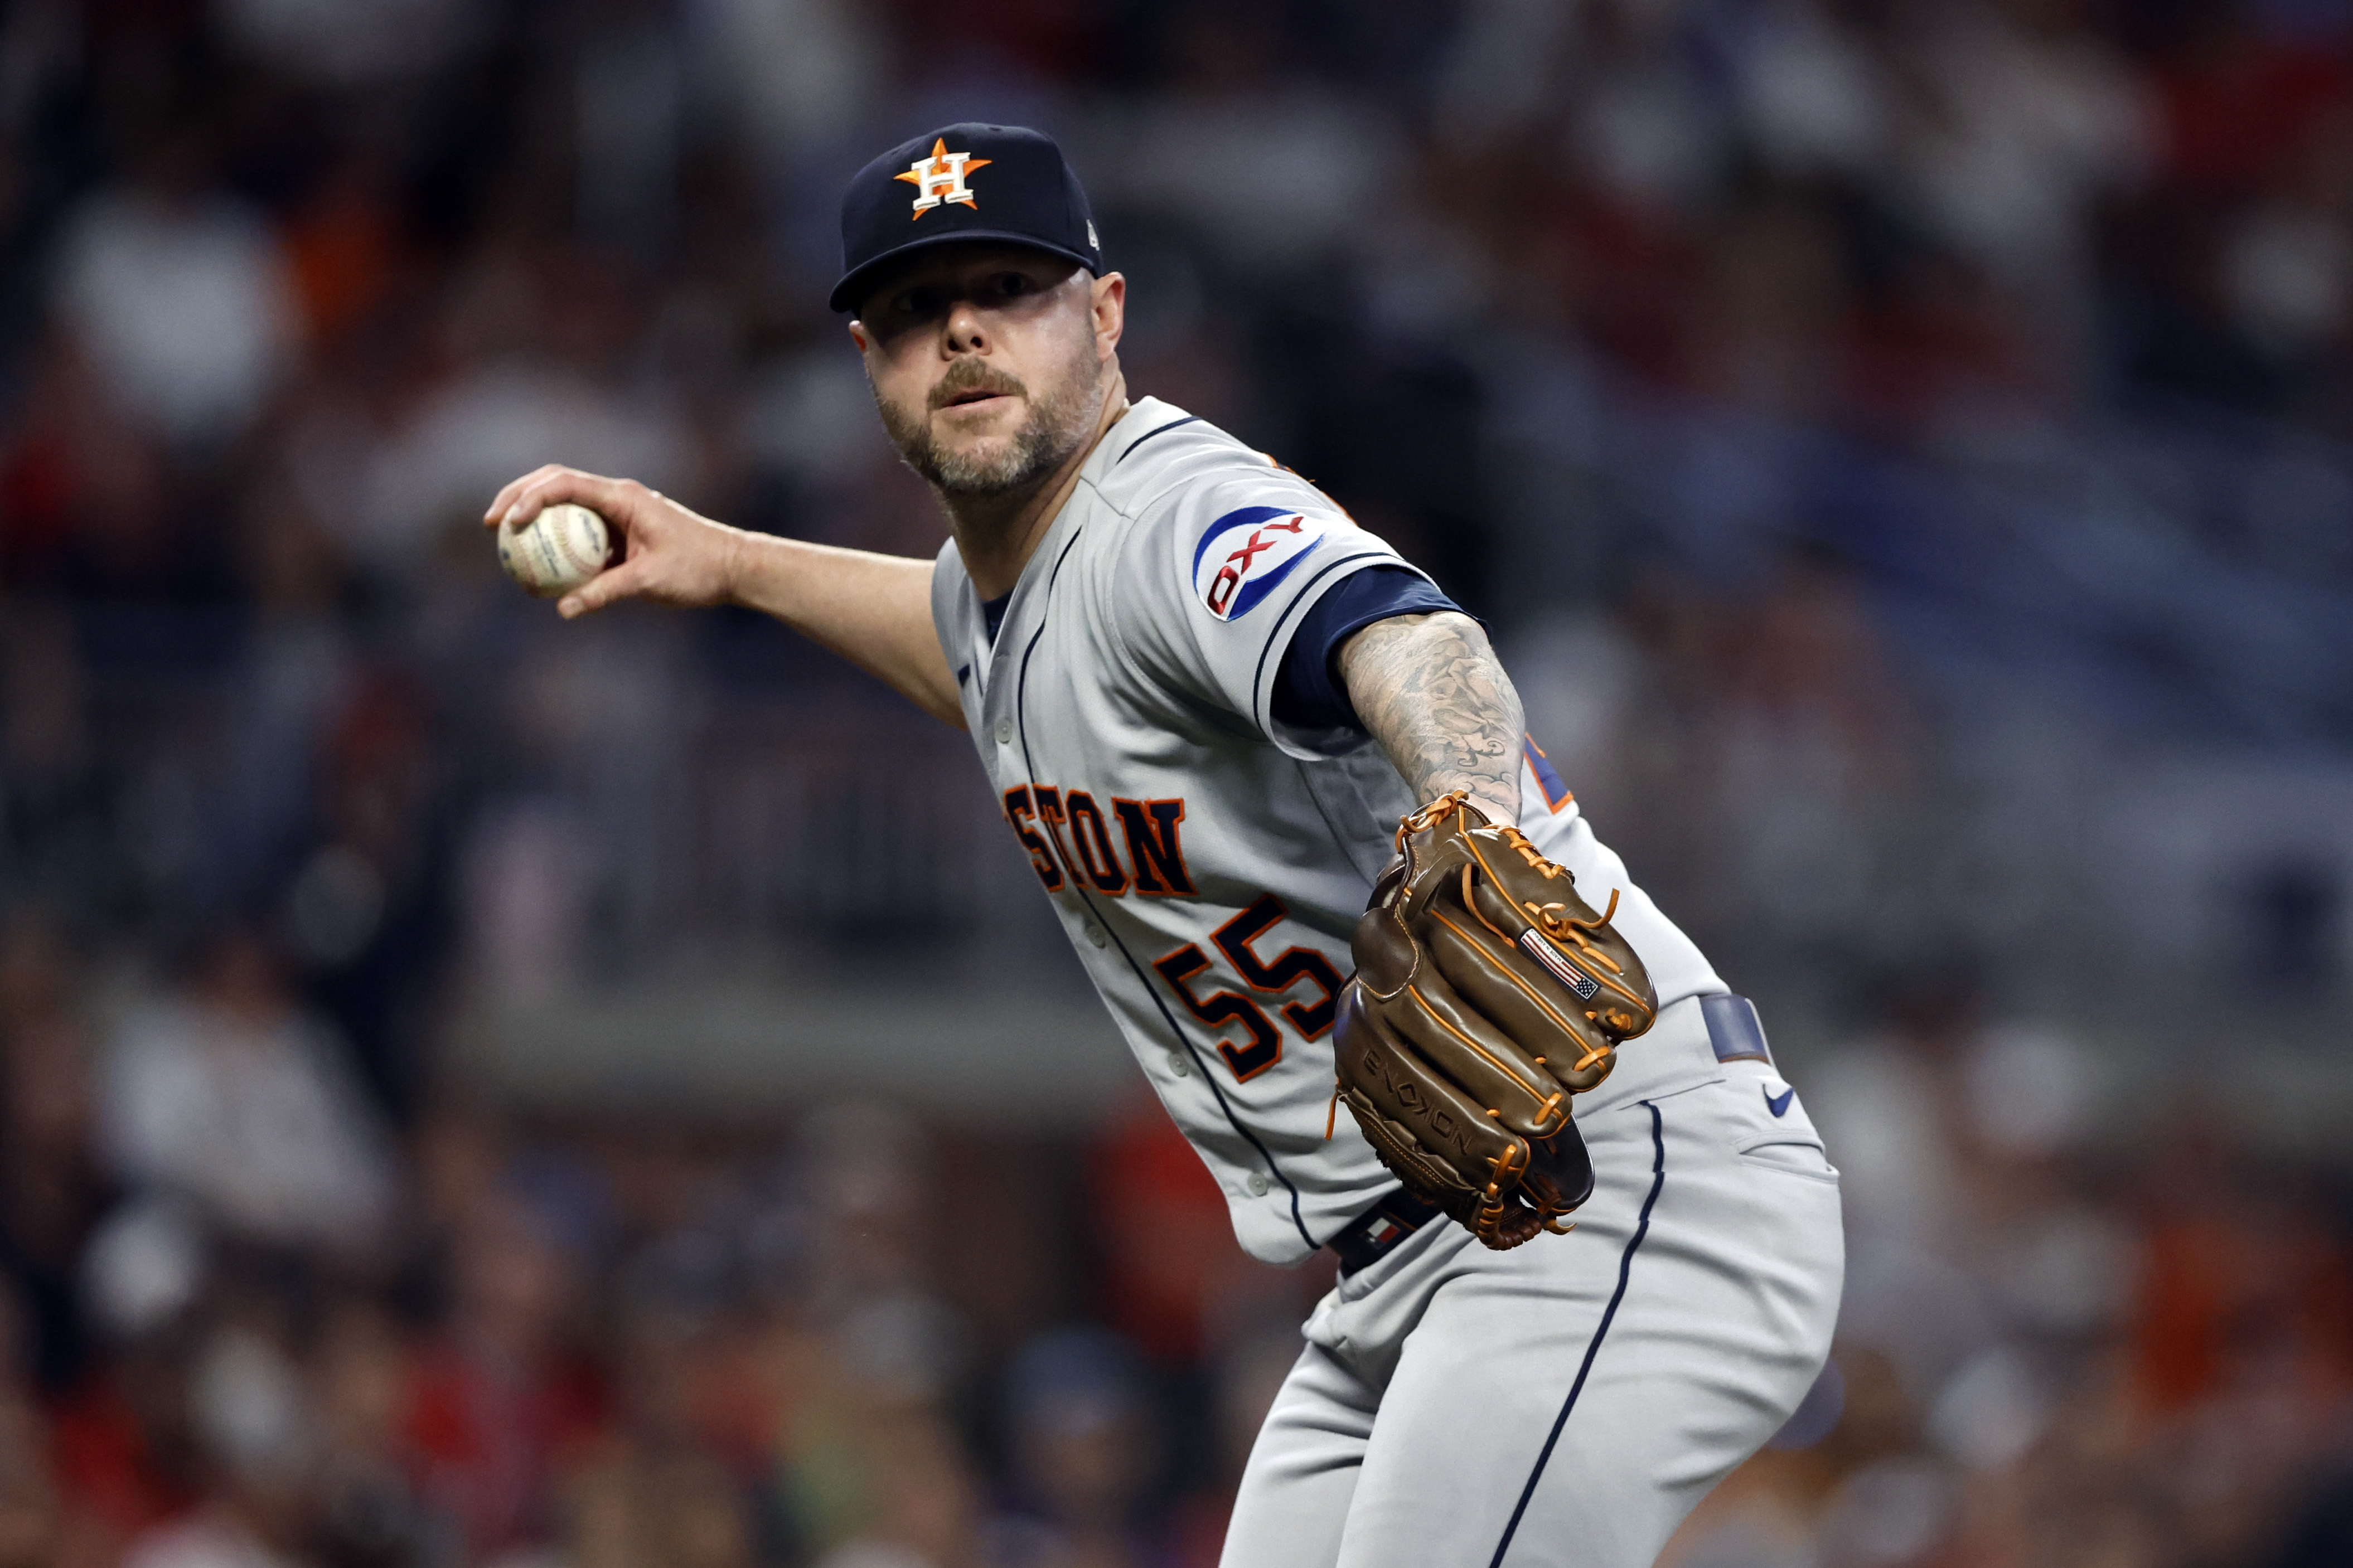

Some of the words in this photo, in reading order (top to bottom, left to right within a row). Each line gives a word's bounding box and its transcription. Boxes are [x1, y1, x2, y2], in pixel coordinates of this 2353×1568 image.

[911, 152, 974, 211] H
[1207, 516, 1304, 615] OXY
[1151, 892, 1345, 1084] 55
